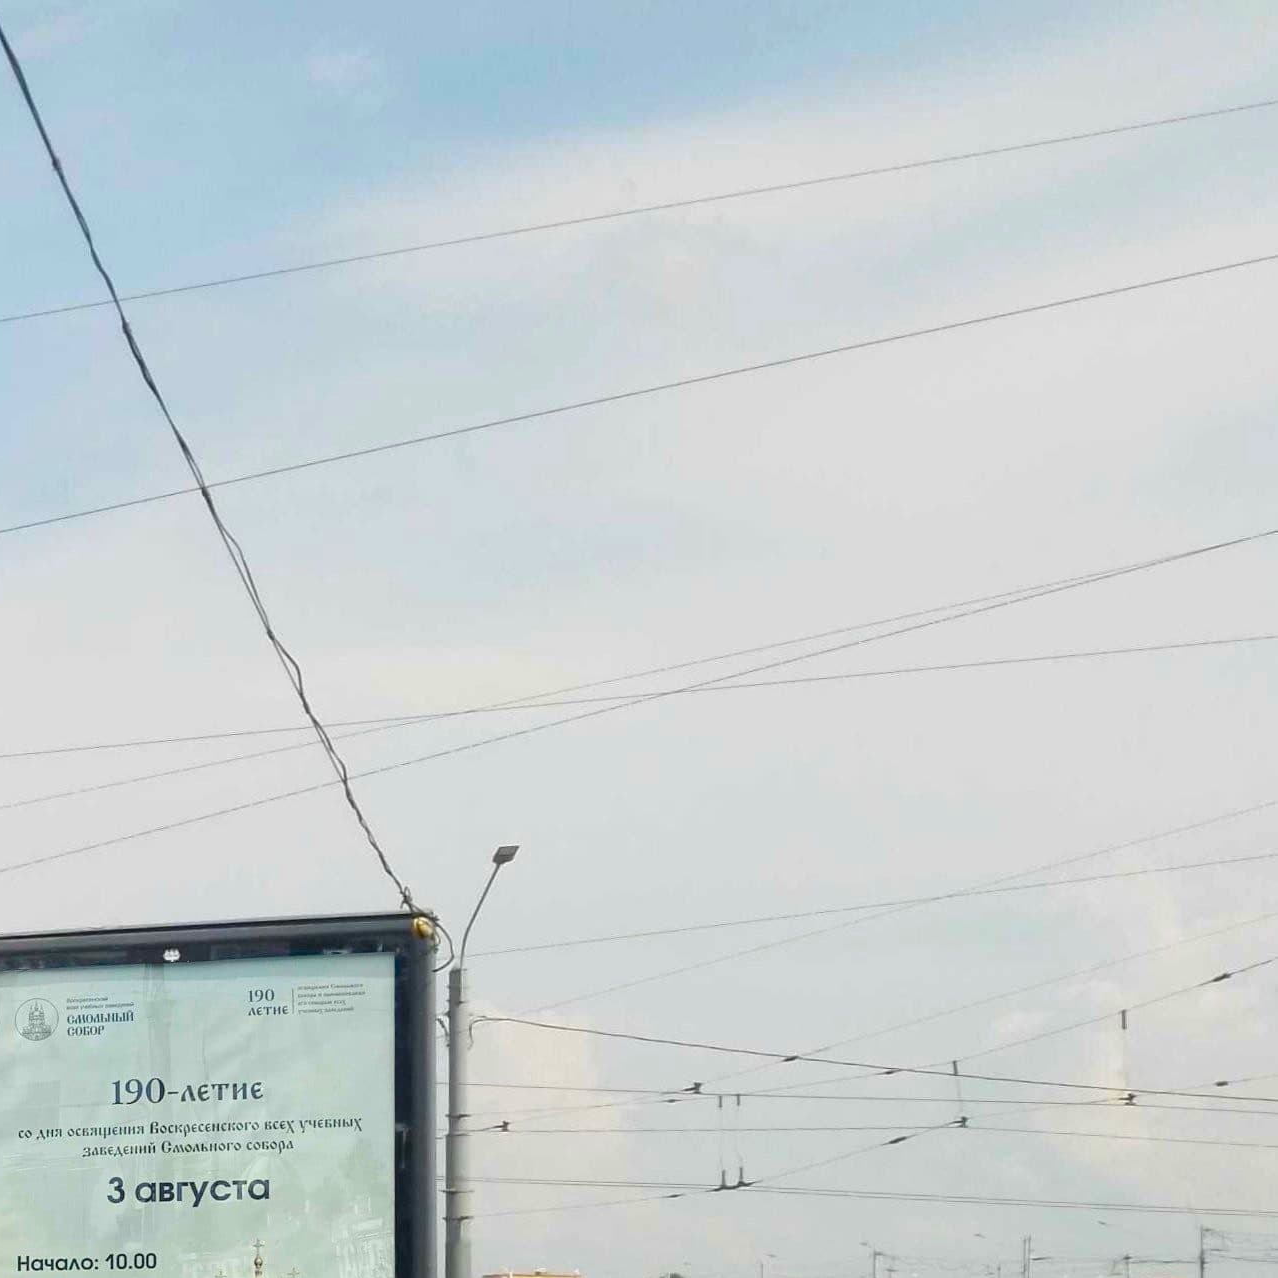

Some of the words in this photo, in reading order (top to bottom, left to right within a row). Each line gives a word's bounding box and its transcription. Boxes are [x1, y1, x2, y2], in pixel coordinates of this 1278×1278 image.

[248, 988, 275, 1002] 190
[18, 1129, 33, 1139] со
[36, 1127, 63, 1140] дня
[67, 1124, 144, 1139] освящения
[149, 1120, 260, 1137] Воскресенского
[264, 1119, 295, 1133] всех
[299, 1117, 362, 1133] учебных
[81, 1142, 156, 1157] заведений
[161, 1140, 242, 1154] Смольного
[246, 1139, 294, 1154] собора
[107, 1176, 125, 1204] 3
[135, 1178, 270, 1208] августа
[17, 1255, 99, 1272] Начало:
[105, 1253, 157, 1270] 10.00
